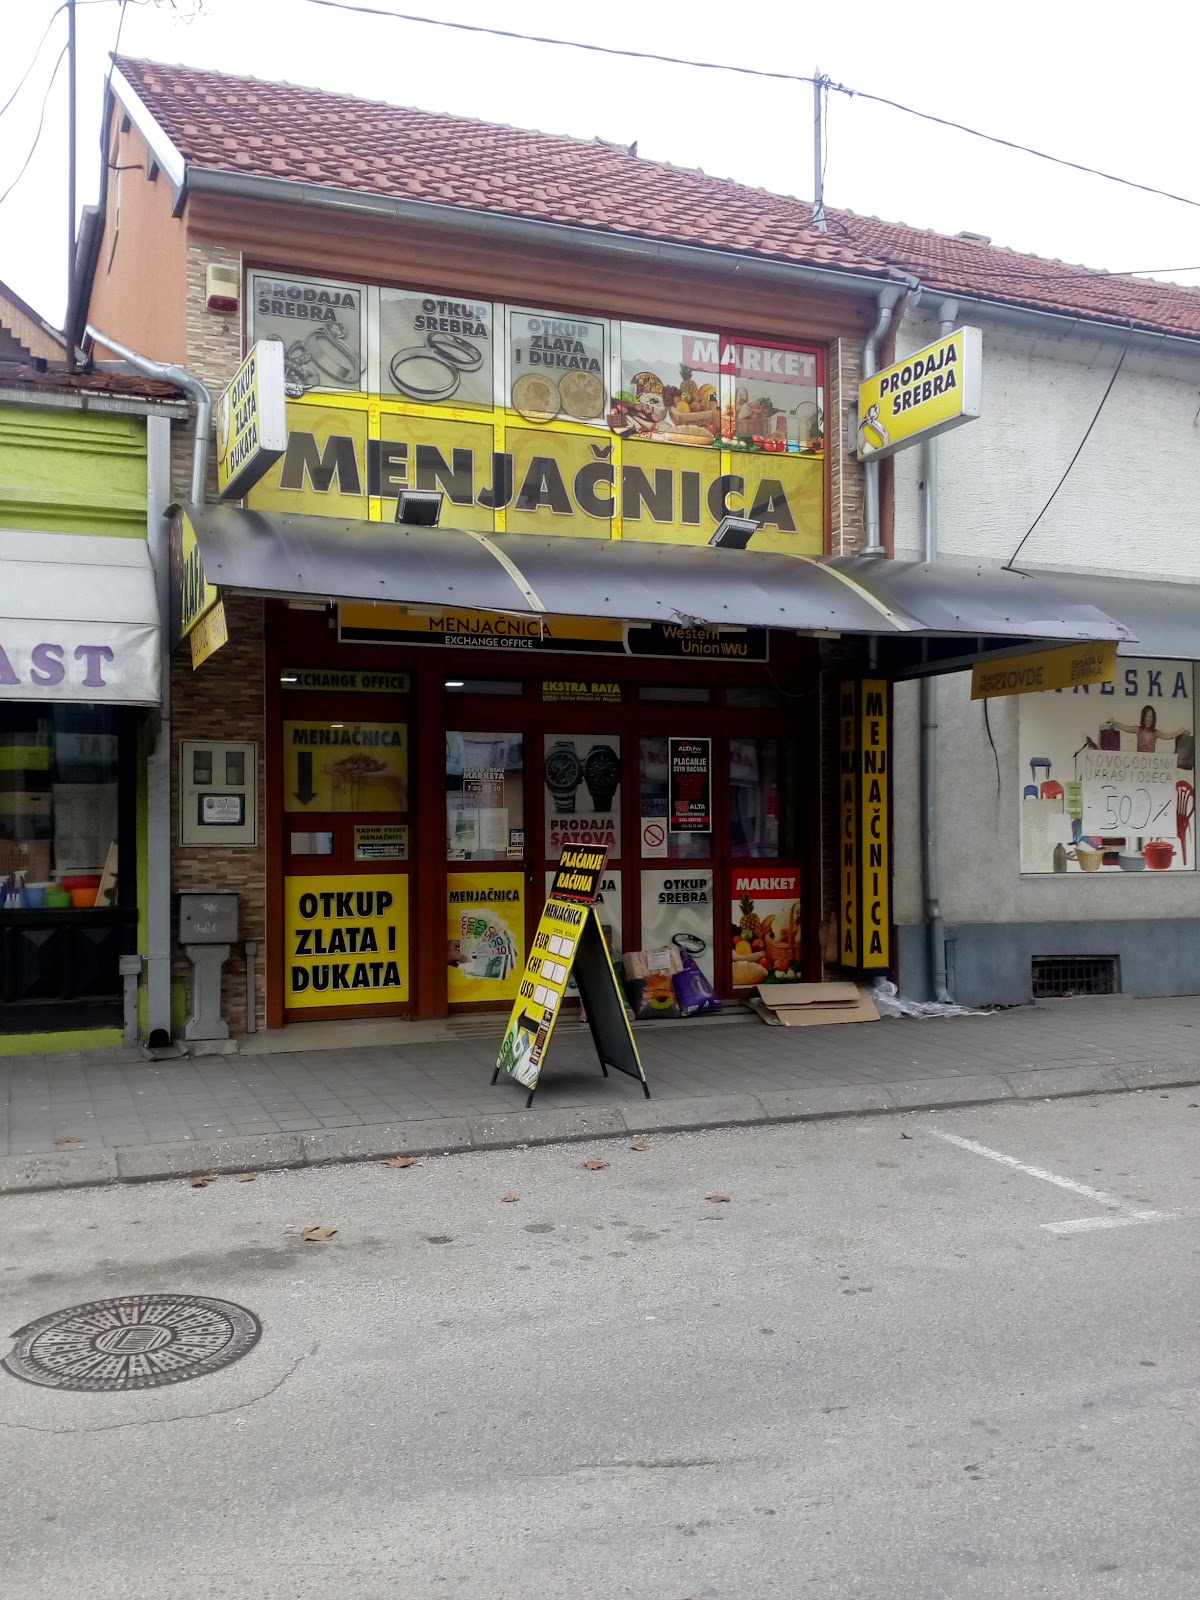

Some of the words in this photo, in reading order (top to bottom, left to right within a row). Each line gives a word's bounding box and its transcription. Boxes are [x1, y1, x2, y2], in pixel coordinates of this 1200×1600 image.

[258, 282, 355, 309] PRODAJA
[258, 300, 338, 322] SREBRA
[422, 299, 488, 319] OTKUP
[414, 314, 488, 338] SREBRA
[527, 318, 589, 340] OTKUP
[530, 335, 586, 357] ZLATA
[529, 350, 601, 372] DUKATA
[691, 339, 816, 378] MARKET
[879, 343, 958, 399] PRODAJA
[232, 358, 255, 409] OTKUP
[892, 369, 957, 415] SREBRA
[235, 390, 257, 437] ZLATA
[230, 421, 258, 474] DUKATA
[279, 430, 798, 533] MENJAČNICA
[429, 616, 552, 637] MENJAČNICA
[662, 625, 720, 640] Western
[444, 635, 499, 647] EXCHANGE
[500, 638, 534, 648] OFFICE
[681, 640, 720, 654] Union
[287, 672, 357, 687] EXCHANGE
[362, 675, 405, 689] OFFICE
[542, 681, 588, 692] EKSTRA
[591, 683, 621, 694] BATA
[1007, 667, 1044, 688] OVDE
[292, 725, 402, 747] MENJAČNICA
[673, 756, 707, 766] PLAĆANJE
[463, 772, 505, 780] MARKETA
[550, 819, 615, 831] PRODAJA
[864, 692, 887, 954] MENJAČNICA
[550, 832, 616, 846] SATOVA
[559, 848, 604, 870] PLAĆANJE
[556, 869, 594, 892] RAČUNA
[663, 879, 707, 890] OTKUP
[735, 877, 796, 891] MARKET
[299, 891, 393, 920] OTKUP
[449, 888, 520, 902] MENJAČNICA
[658, 892, 708, 902] SREBRA
[543, 903, 583, 926] MENJAČNICA
[294, 927, 379, 956] ZLATA
[388, 926, 396, 952] I
[534, 931, 550, 950] EUR
[528, 956, 542, 974] CHF
[291, 961, 402, 993] DUKATA
[520, 979, 535, 999] USD
